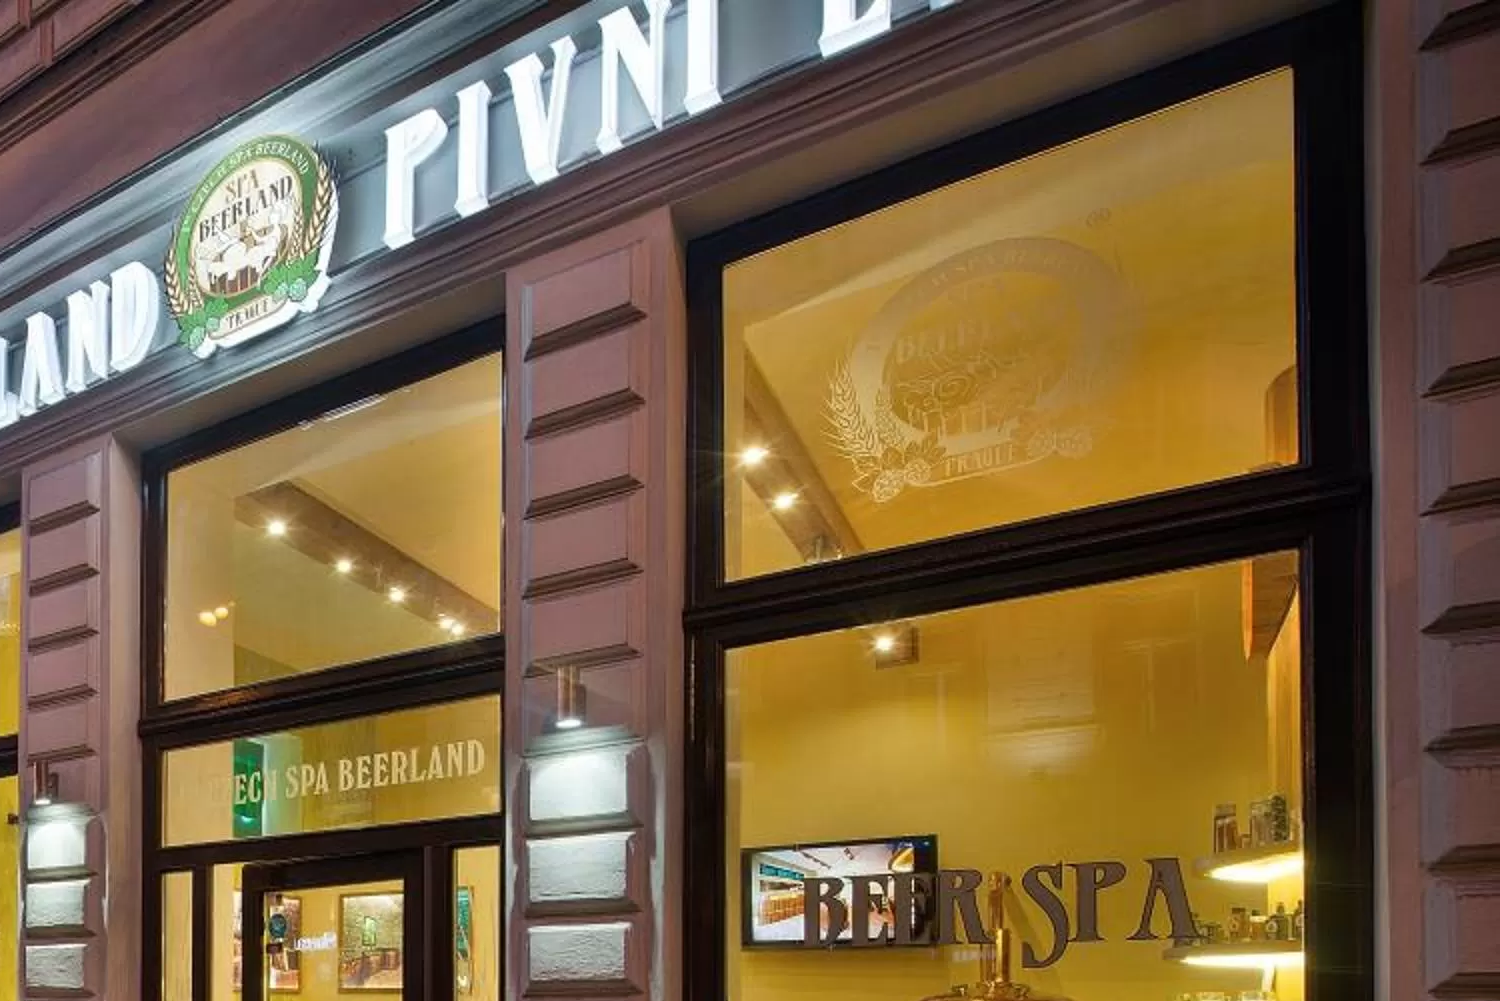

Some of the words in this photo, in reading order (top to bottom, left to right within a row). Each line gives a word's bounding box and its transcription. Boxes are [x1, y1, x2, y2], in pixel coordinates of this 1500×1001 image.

[199, 175, 293, 242] BEERLAND
[224, 168, 259, 203] SPA
[284, 762, 330, 800] SPA
[338, 739, 486, 792] BEERLAND
[803, 868, 995, 947] BEER
[1020, 856, 1203, 969] SPA
